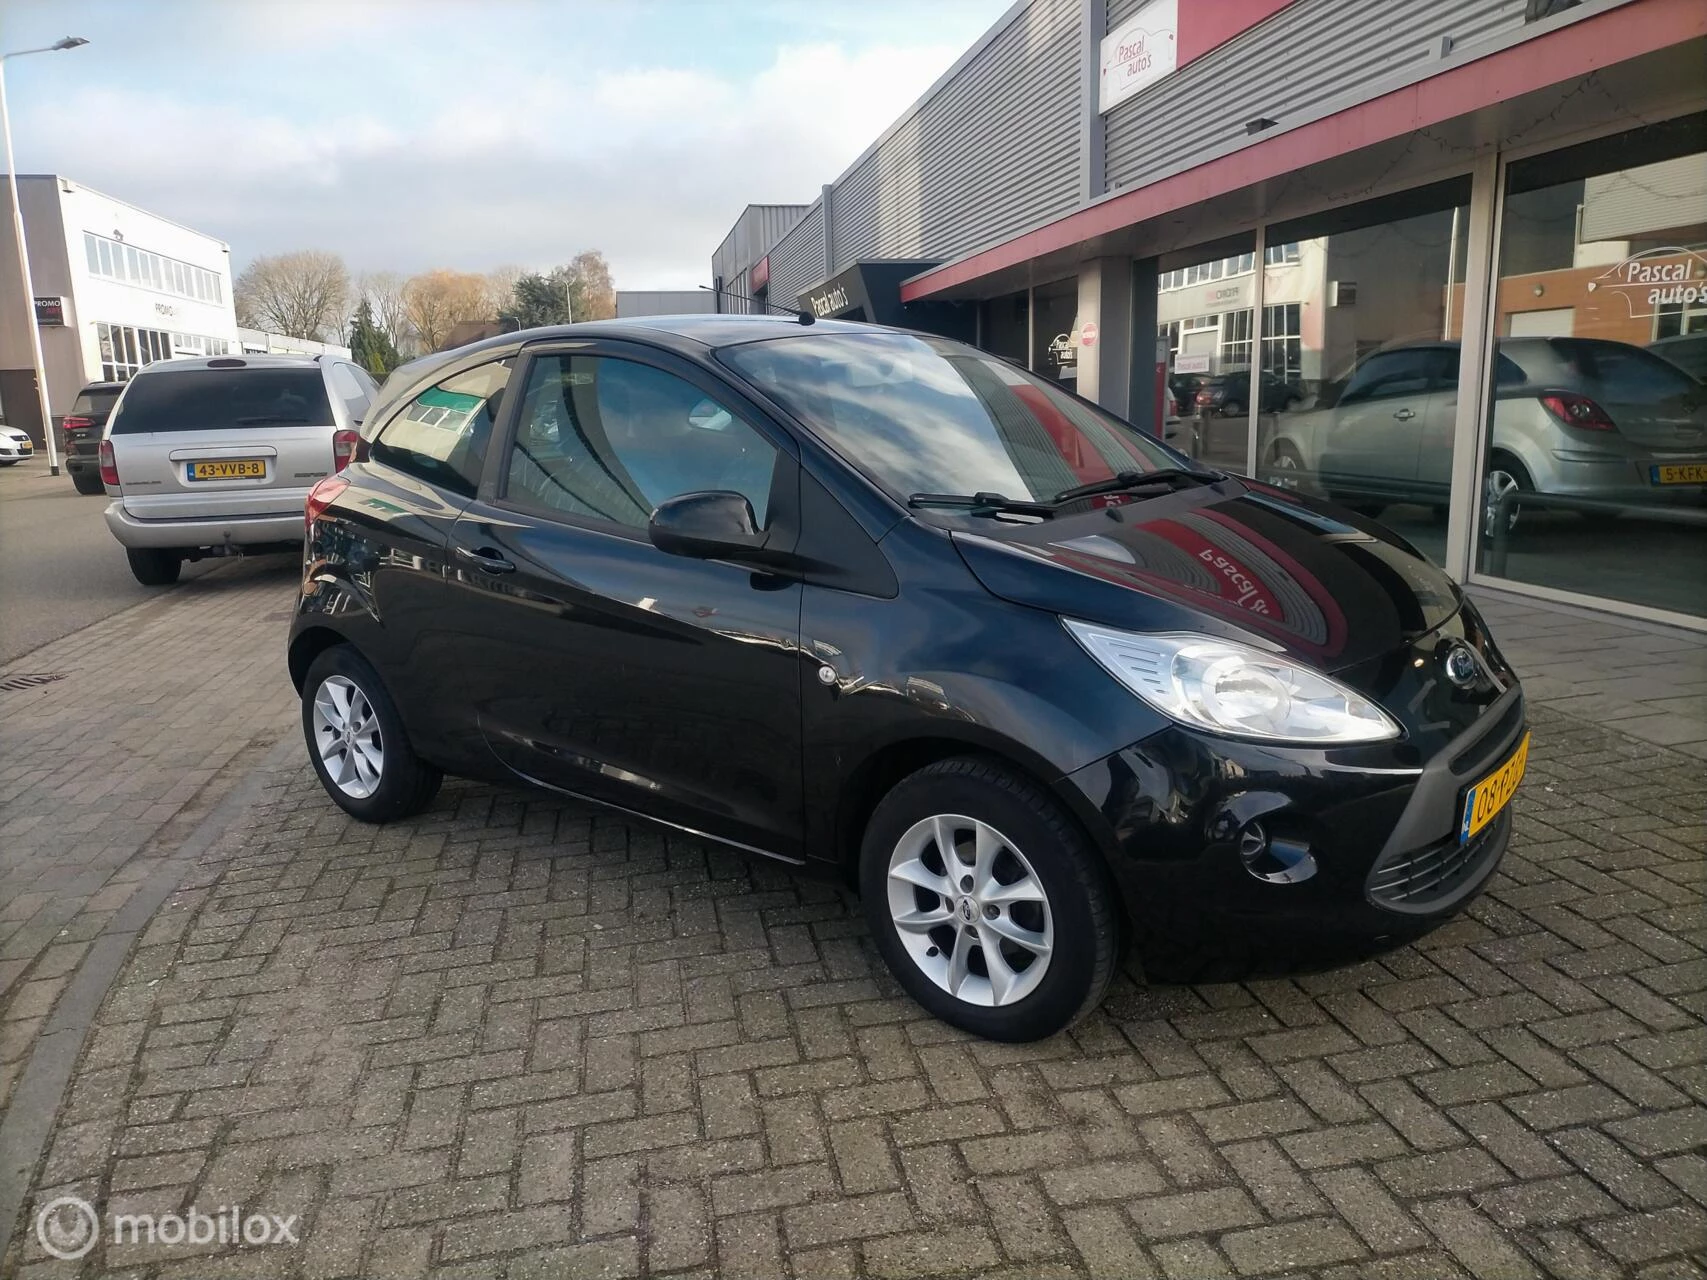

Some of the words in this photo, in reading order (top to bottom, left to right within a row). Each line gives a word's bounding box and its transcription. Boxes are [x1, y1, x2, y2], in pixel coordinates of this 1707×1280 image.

[1118, 35, 1145, 63] Pascal
[1627, 258, 1692, 283] Pascal
[1647, 281, 1707, 305] auto's
[200, 463, 260, 475] 43-VVB-8
